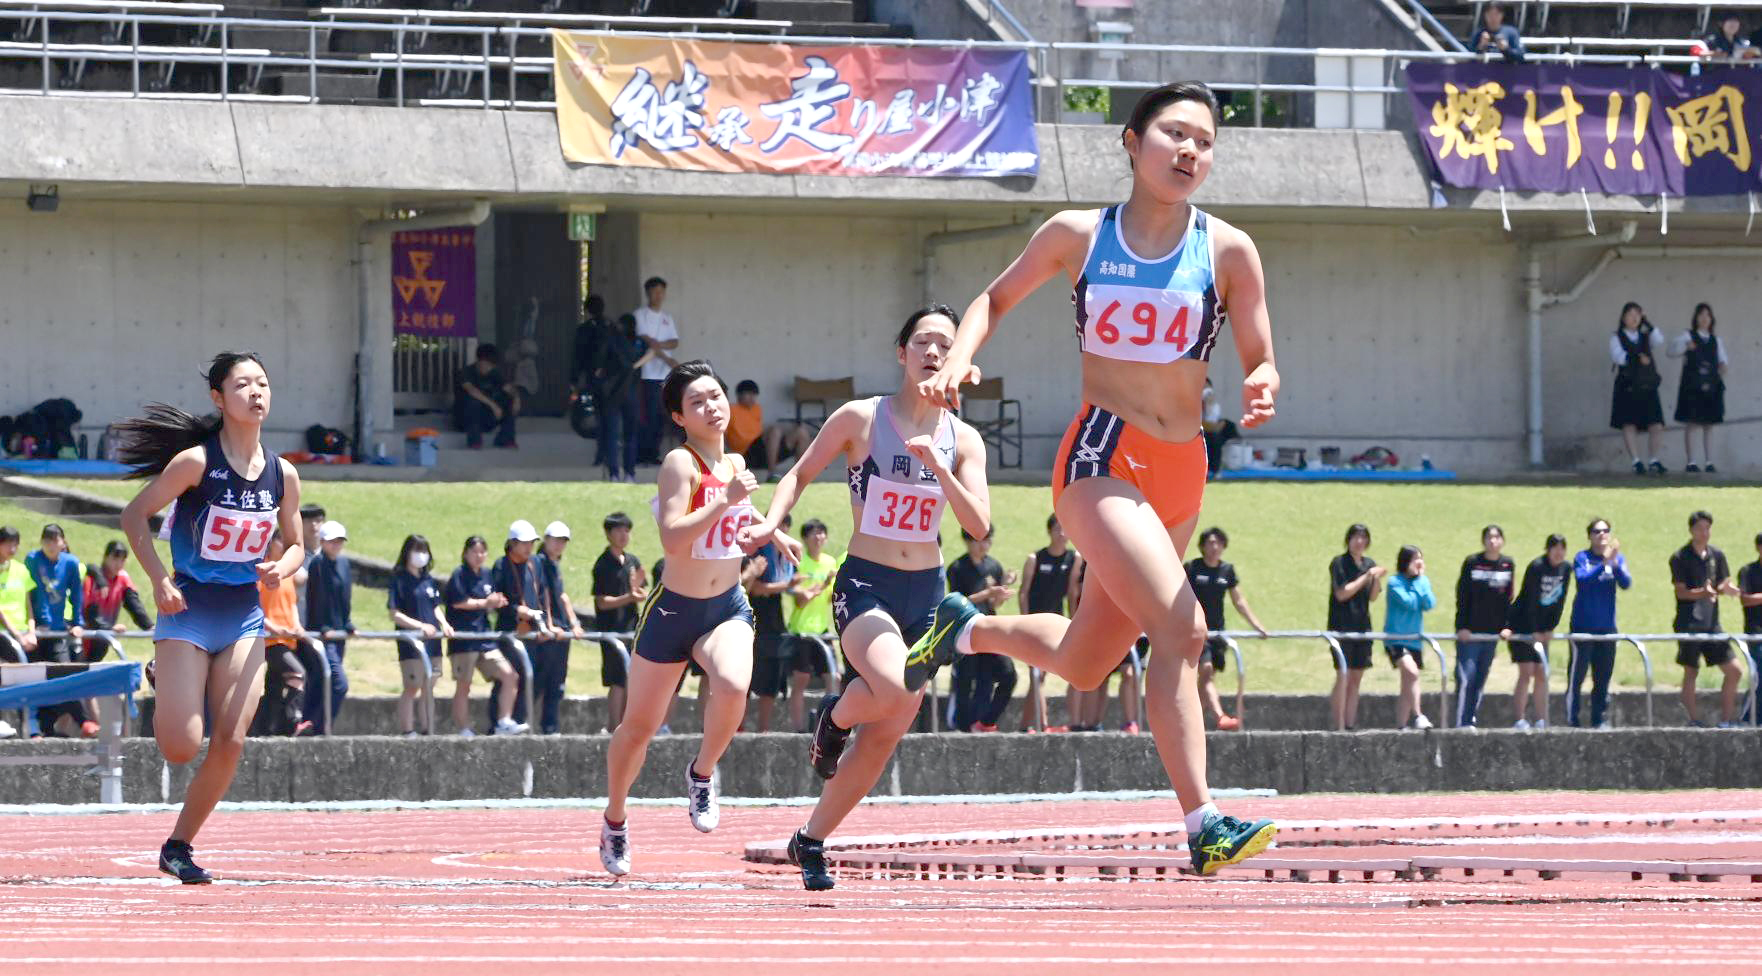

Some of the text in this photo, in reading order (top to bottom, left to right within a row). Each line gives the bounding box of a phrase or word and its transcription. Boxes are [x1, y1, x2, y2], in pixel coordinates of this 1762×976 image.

[1100, 260, 1136, 278] 高知国際
[1096, 300, 1189, 352] 694
[220, 488, 275, 510] 土佐塾
[879, 491, 937, 532] 326
[207, 515, 273, 554] 513
